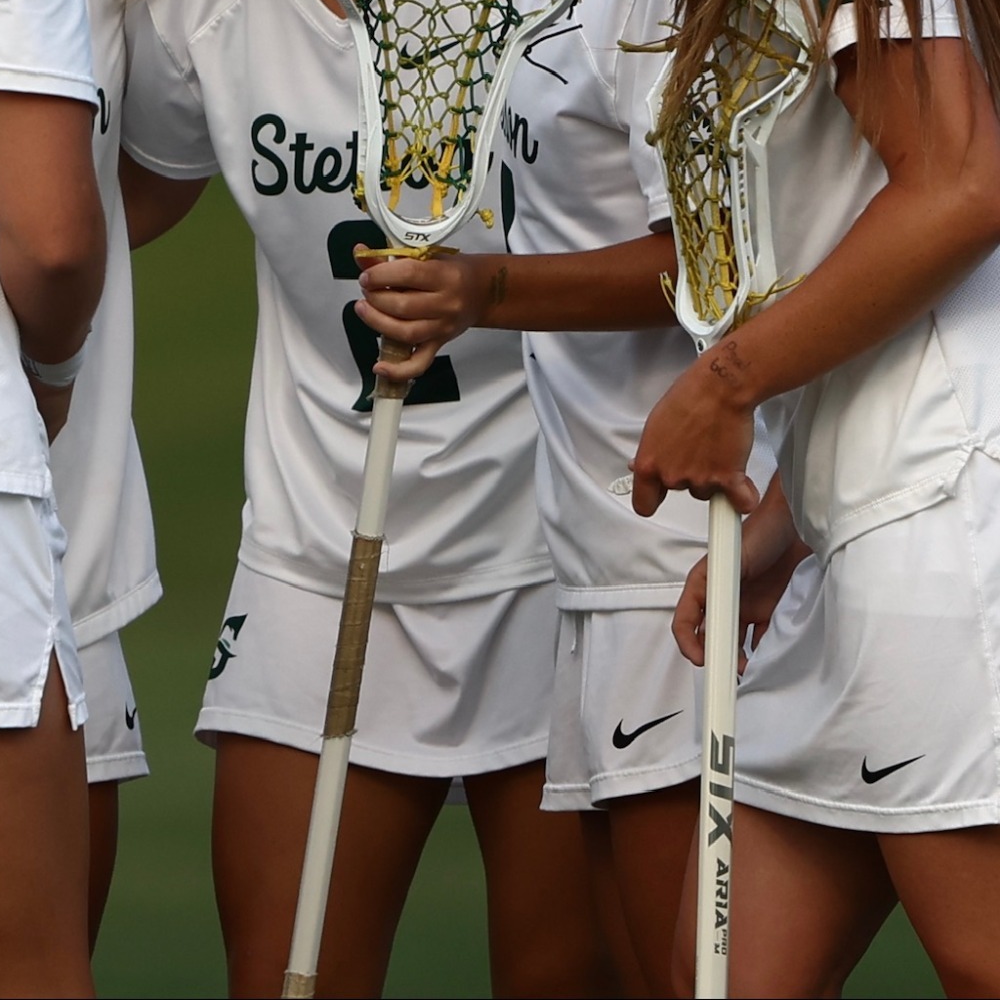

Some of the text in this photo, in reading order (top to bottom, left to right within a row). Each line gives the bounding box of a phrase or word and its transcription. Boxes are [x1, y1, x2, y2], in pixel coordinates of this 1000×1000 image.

[404, 231, 432, 242] STX
[708, 730, 736, 847] STX
[714, 857, 730, 931] ARIA
